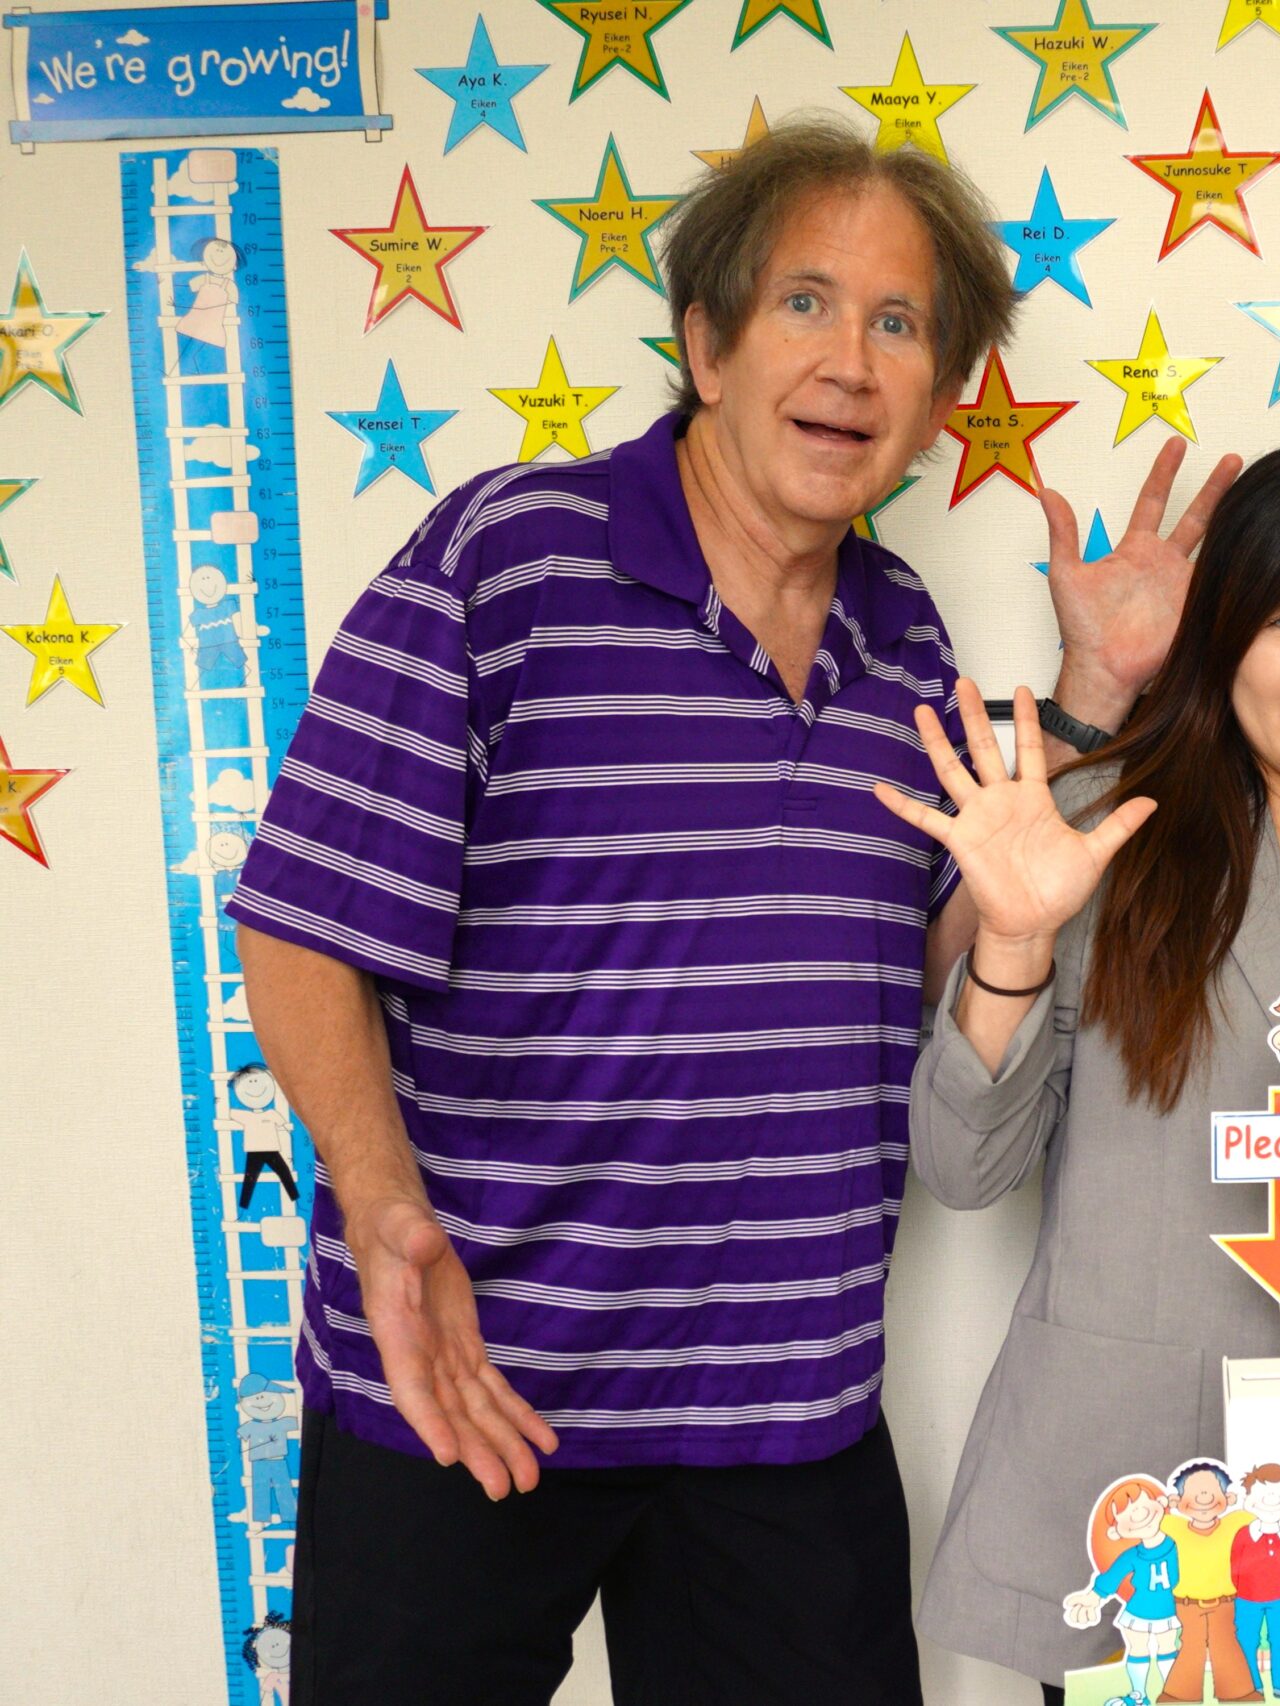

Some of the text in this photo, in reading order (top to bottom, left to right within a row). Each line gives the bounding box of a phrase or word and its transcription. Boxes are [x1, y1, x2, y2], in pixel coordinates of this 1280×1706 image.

[580, 8, 627, 24] Ryusei
[604, 33, 630, 43] Eiken
[1034, 36, 1084, 50] Hazuki
[603, 44, 631, 55] Pre-2
[40, 29, 350, 97] We're growing!
[1062, 62, 1088, 71] Eiken
[1060, 72, 1089, 81] Pre-2
[458, 75, 485, 91] Aya
[471, 99, 496, 109] Eiken
[871, 92, 919, 109] Maaya
[1164, 163, 1231, 177] Junnosuke
[1196, 190, 1223, 200] Eiken
[243, 213, 257, 225] 70
[579, 208, 624, 221] Noeru
[601, 233, 627, 242] Eiken
[1023, 226, 1045, 240] Rei
[369, 239, 419, 252] Sumire
[600, 243, 628, 253] Pre-2
[1035, 253, 1061, 263] Eiken
[396, 264, 421, 273] Eiken
[245, 274, 259, 286] 68
[1123, 365, 1158, 378] Rena
[519, 394, 565, 407] Yuzuki
[1142, 391, 1168, 401] Eiken
[358, 418, 403, 430] Kensei
[542, 420, 568, 429] Eiken
[967, 415, 1001, 428] Kota
[255, 428, 270, 440] 63
[380, 443, 406, 453] Eiken
[984, 440, 1010, 449] Eiken
[259, 488, 272, 500] 61
[260, 518, 276, 530] 60
[265, 578, 278, 590] 58
[26, 631, 74, 644] Kokona
[268, 638, 281, 650] 56
[49, 656, 73, 665] Eiken
[1149, 1561, 1170, 1591] H
